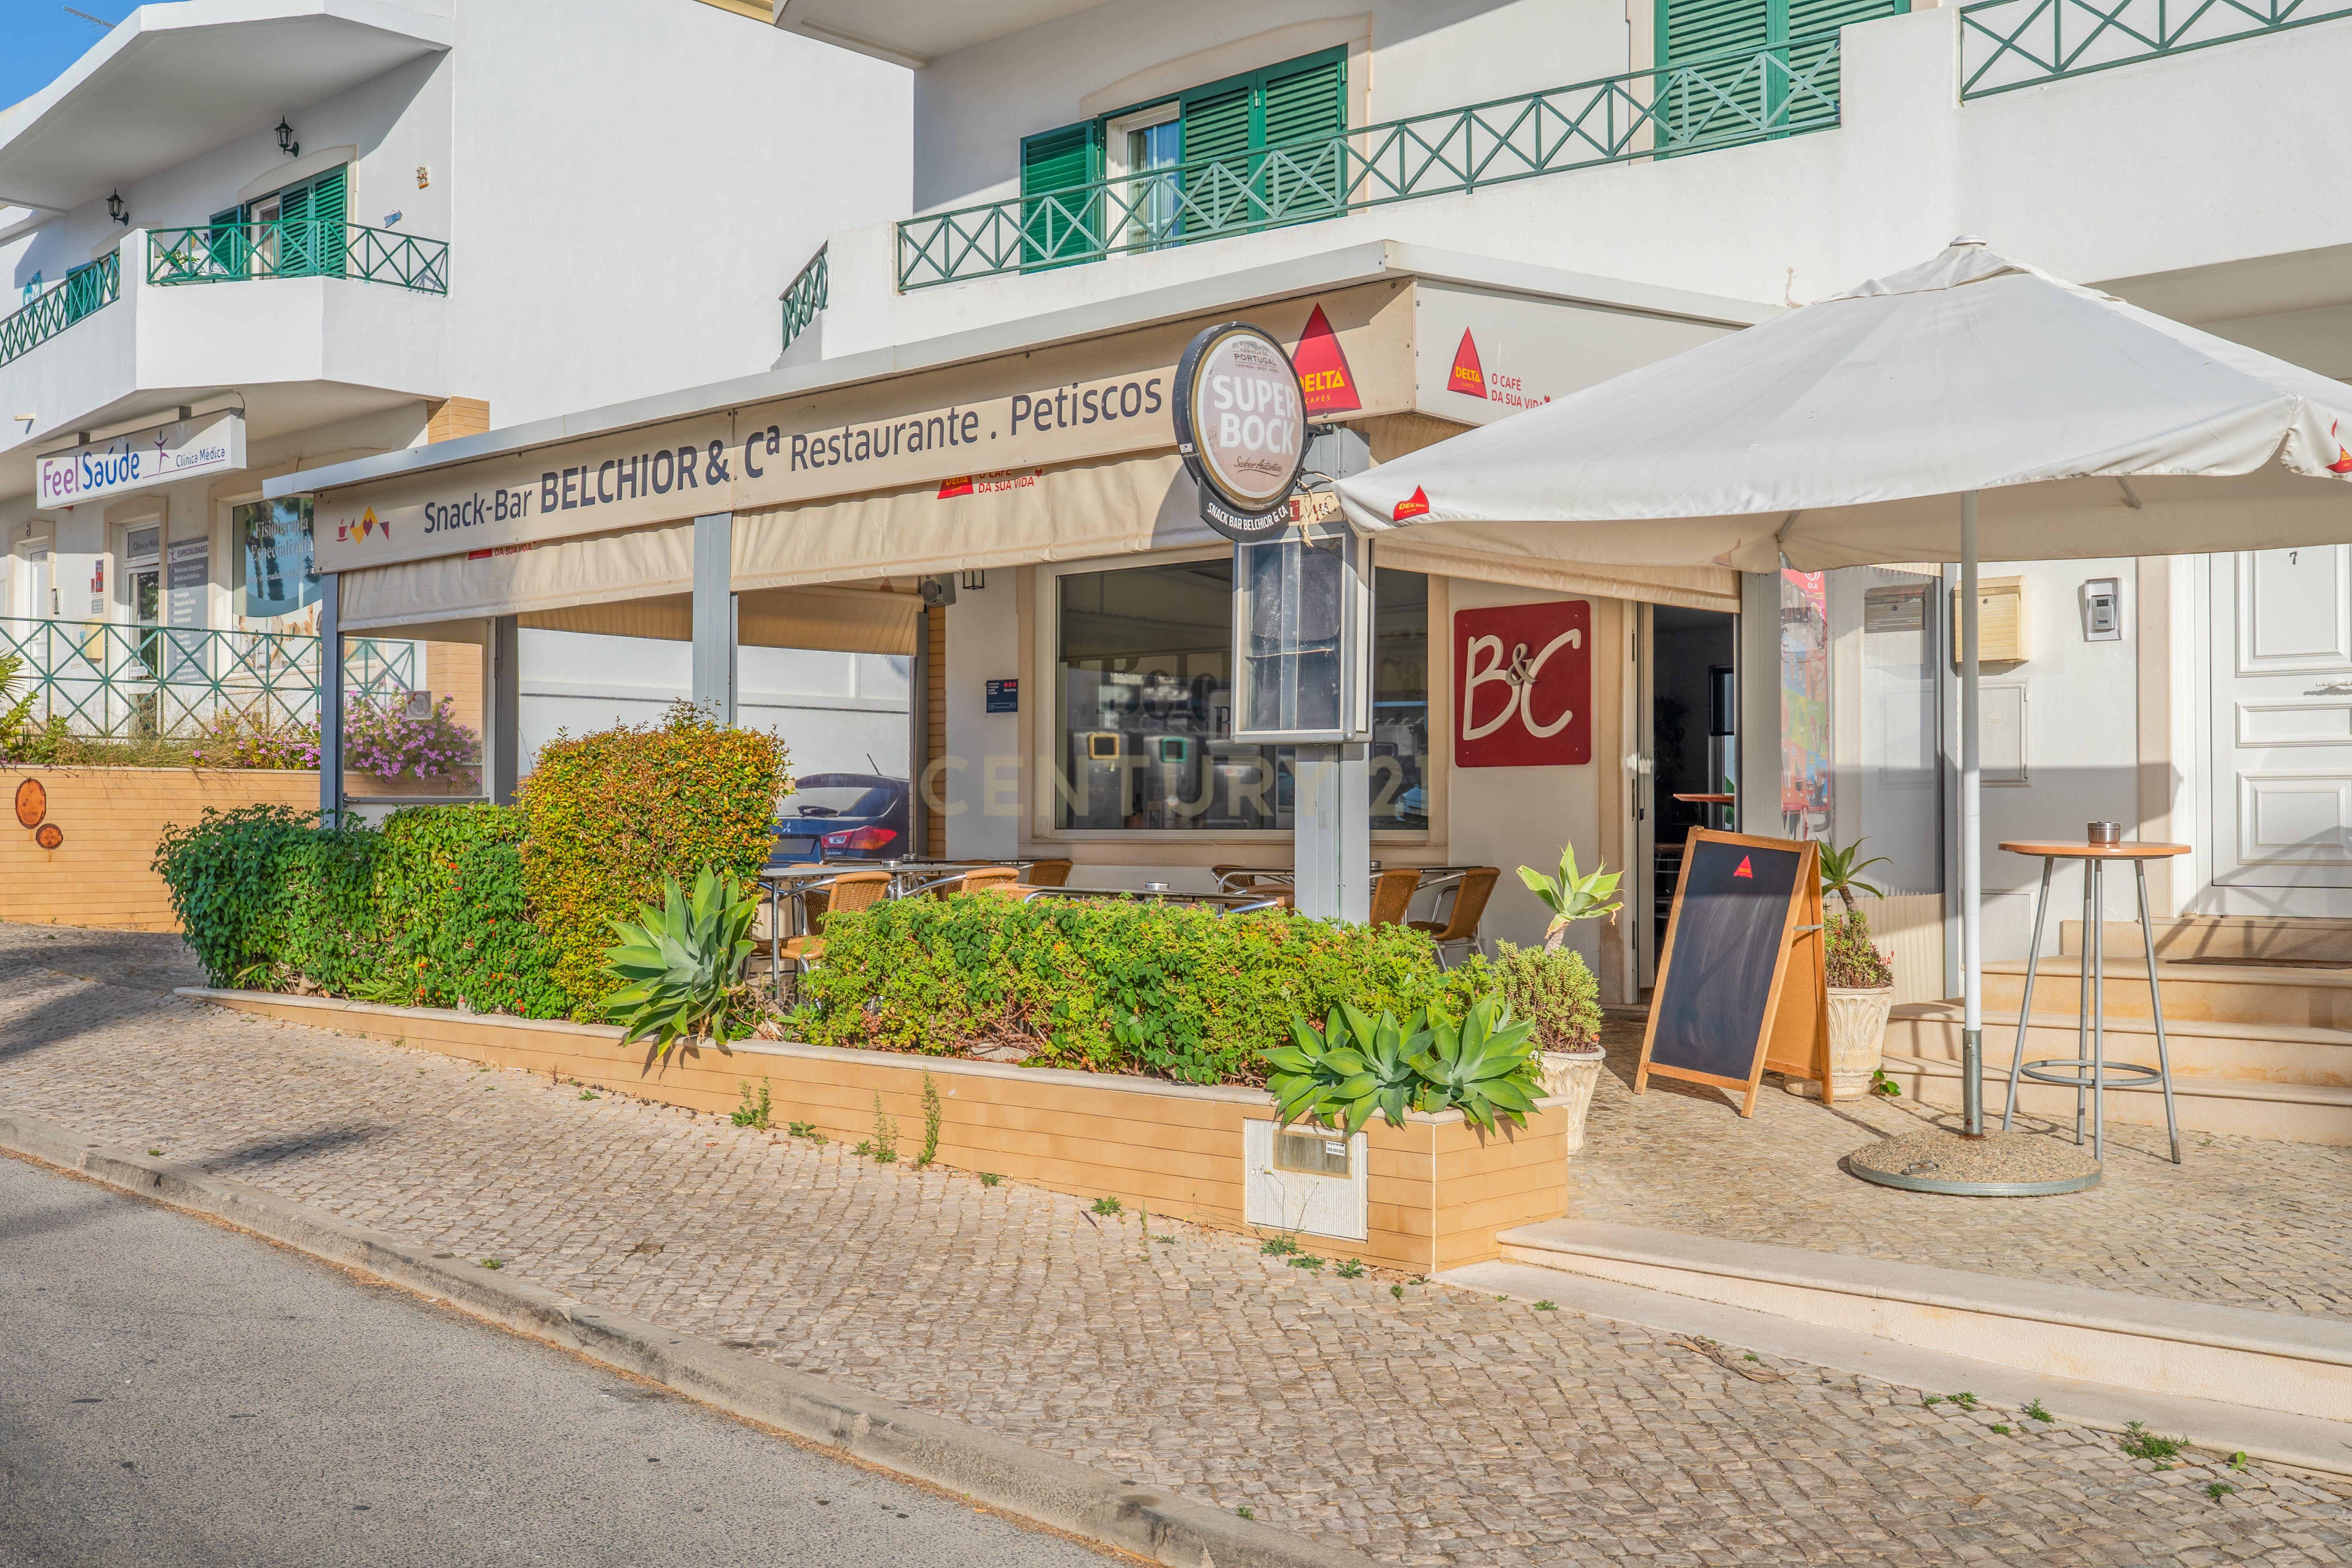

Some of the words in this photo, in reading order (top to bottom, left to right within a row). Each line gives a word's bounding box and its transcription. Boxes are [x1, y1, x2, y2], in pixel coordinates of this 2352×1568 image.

[1234, 353, 1277, 366] PORTUGAL
[1456, 366, 1481, 383] DELTA
[1492, 373, 1498, 385] O
[1501, 375, 1521, 391] CAFÉ
[1212, 375, 1297, 419] SUPER
[1492, 390, 1503, 403] DA
[1506, 393, 1522, 407] SUA
[1219, 413, 1295, 456] BOCK
[176, 454, 198, 467] Clínica
[200, 447, 225, 462] Médica
[424, 489, 532, 534] Snack-Bar
[540, 446, 699, 514] BELCHIOR
[705, 439, 730, 485] &
[791, 407, 978, 472] Restaurante
[1011, 378, 1161, 436] Petiscos
[1234, 456, 1256, 468] Sabor
[978, 483, 992, 493] DA
[995, 481, 1012, 491] SUA
[1014, 476, 1034, 488] VIDA
[1207, 503, 1228, 525] SNACK
[1229, 516, 1243, 530] BAR
[1243, 514, 1274, 530] BELCHIOR
[1272, 512, 1280, 523] &
[1278, 505, 1289, 518] CA
[25, 522, 31, 537] 8
[255, 514, 309, 539] Fisioterapia
[133, 541, 148, 550] Clínica
[149, 538, 159, 548] Médi
[178, 545, 208, 558] ESPECIALIDADES
[251, 536, 314, 564] Especializada
[495, 548, 504, 556] DA
[506, 545, 517, 555] SUA
[2289, 551, 2297, 565] 7
